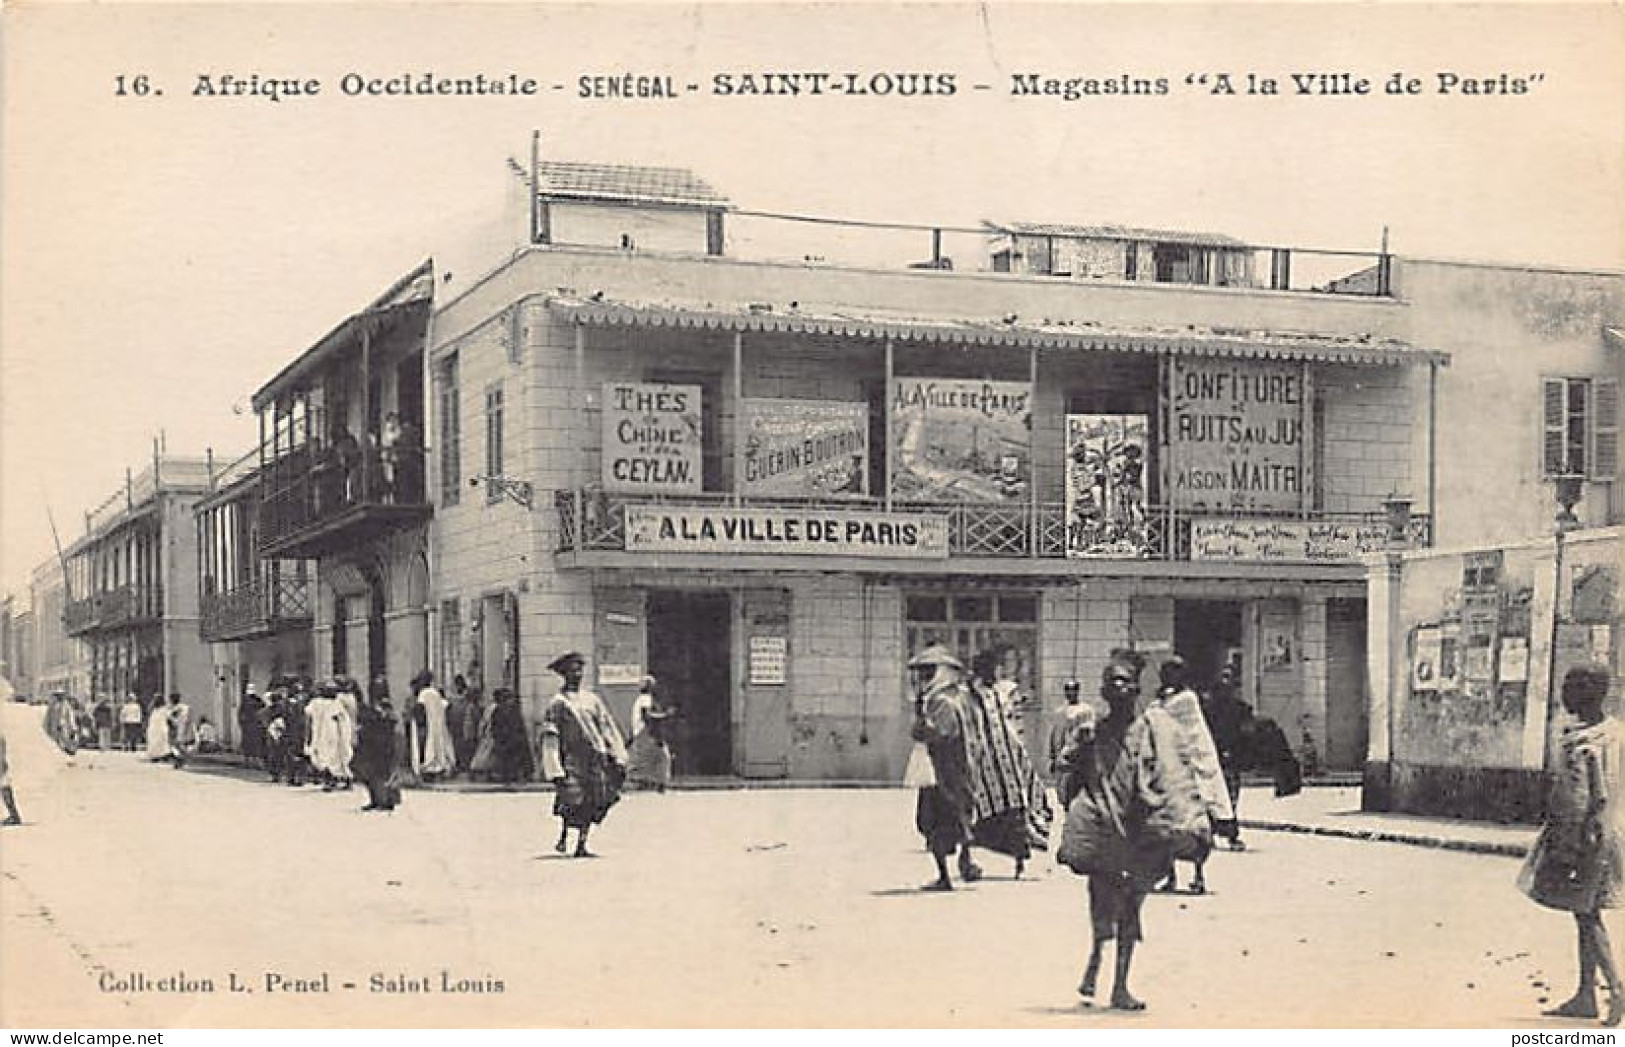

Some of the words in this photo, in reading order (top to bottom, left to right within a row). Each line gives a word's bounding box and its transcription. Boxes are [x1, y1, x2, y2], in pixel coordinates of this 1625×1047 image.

[659, 516, 676, 540] A
[681, 516, 717, 541] LA
[722, 517, 800, 542] VILLE
[806, 520, 839, 543] DE
[845, 520, 918, 546] PARIS
